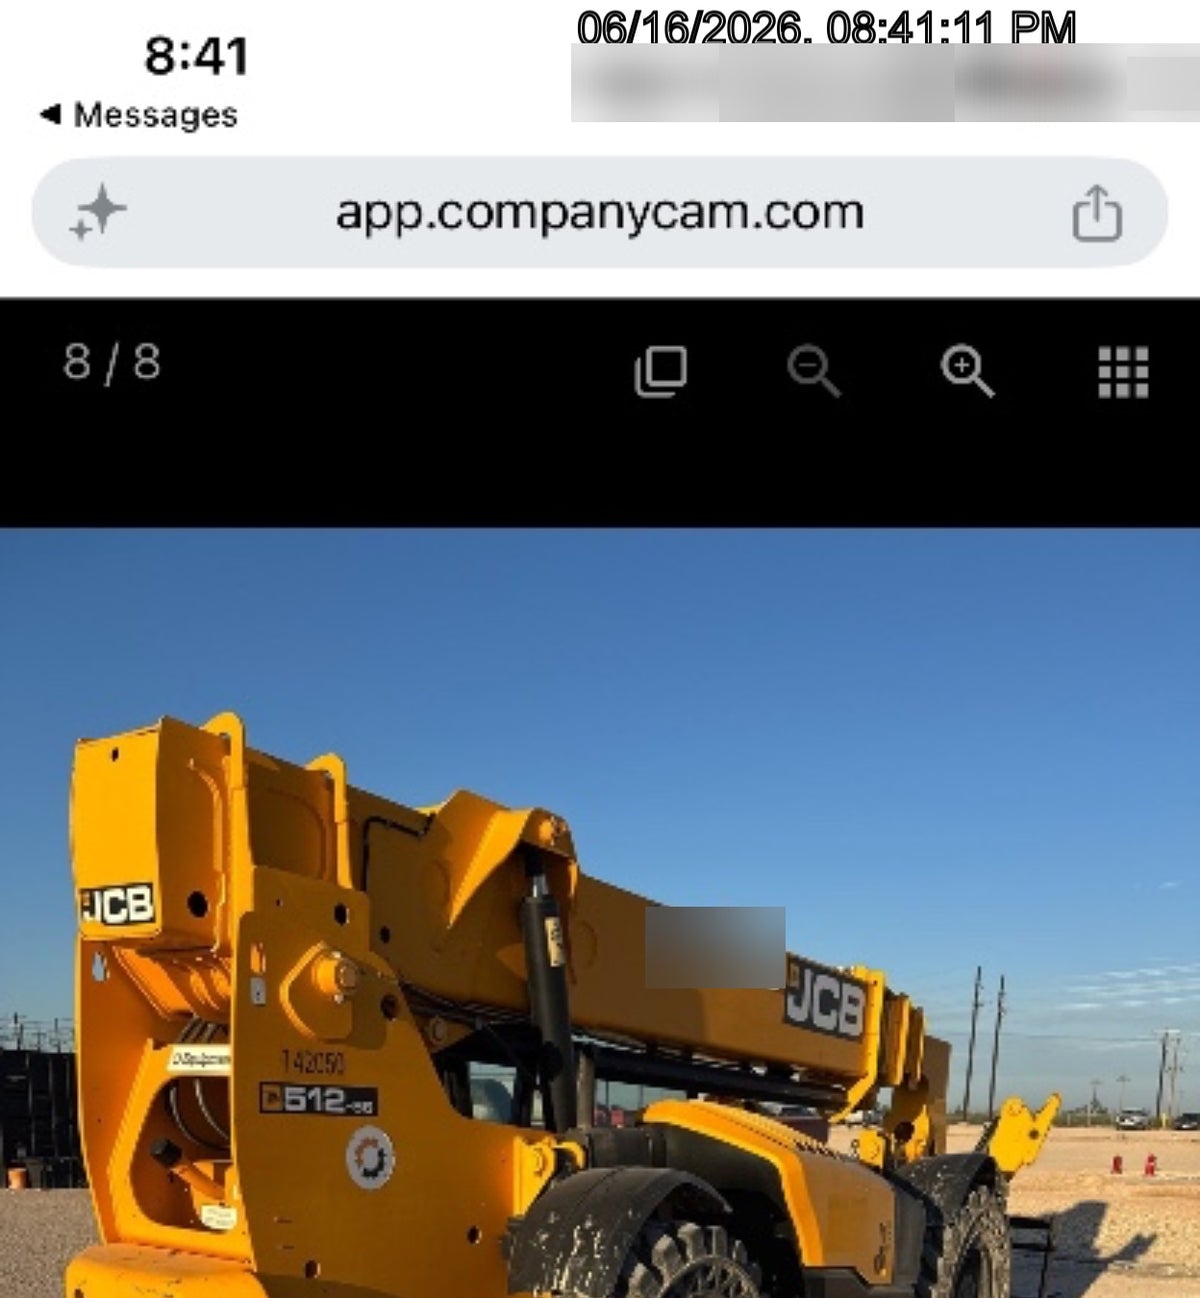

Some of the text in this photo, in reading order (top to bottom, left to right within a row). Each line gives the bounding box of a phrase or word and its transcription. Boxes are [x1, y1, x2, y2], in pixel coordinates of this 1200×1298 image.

[145, 35, 246, 76] 8:41
[75, 101, 238, 134] Messages
[336, 196, 864, 240] app.companycam.com
[63, 342, 91, 380] 8
[134, 342, 160, 380] 8
[82, 886, 154, 924] JCB
[786, 968, 867, 1037] JCB
